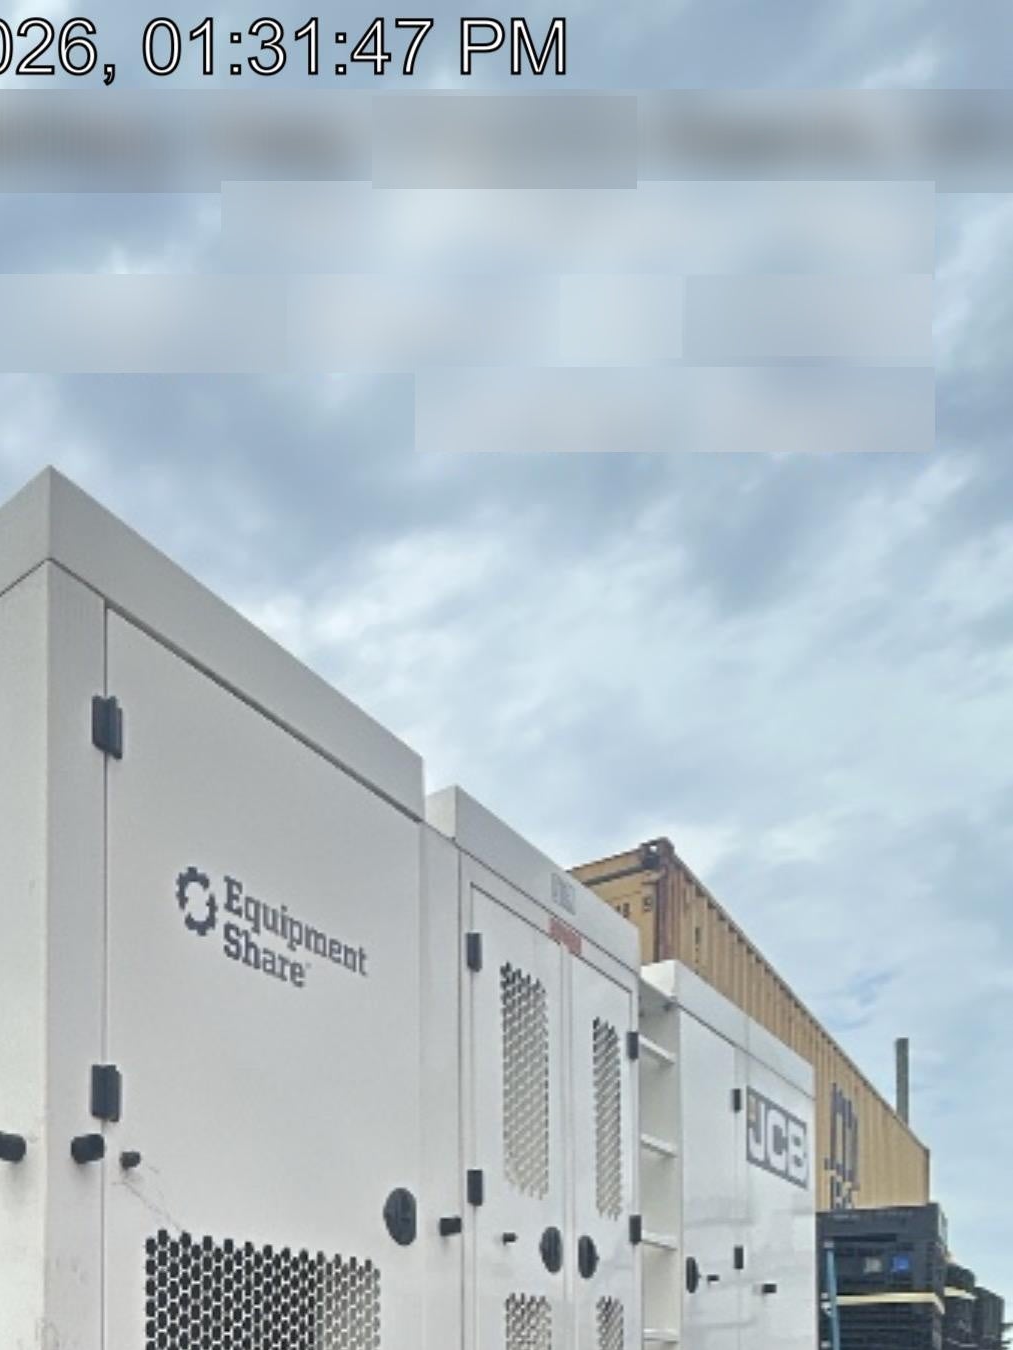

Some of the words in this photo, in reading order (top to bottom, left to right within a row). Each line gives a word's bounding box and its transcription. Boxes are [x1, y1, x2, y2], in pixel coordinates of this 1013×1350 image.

[223, 875, 368, 976] Equipment
[223, 921, 306, 987] Share
[747, 1091, 808, 1184] JCB
